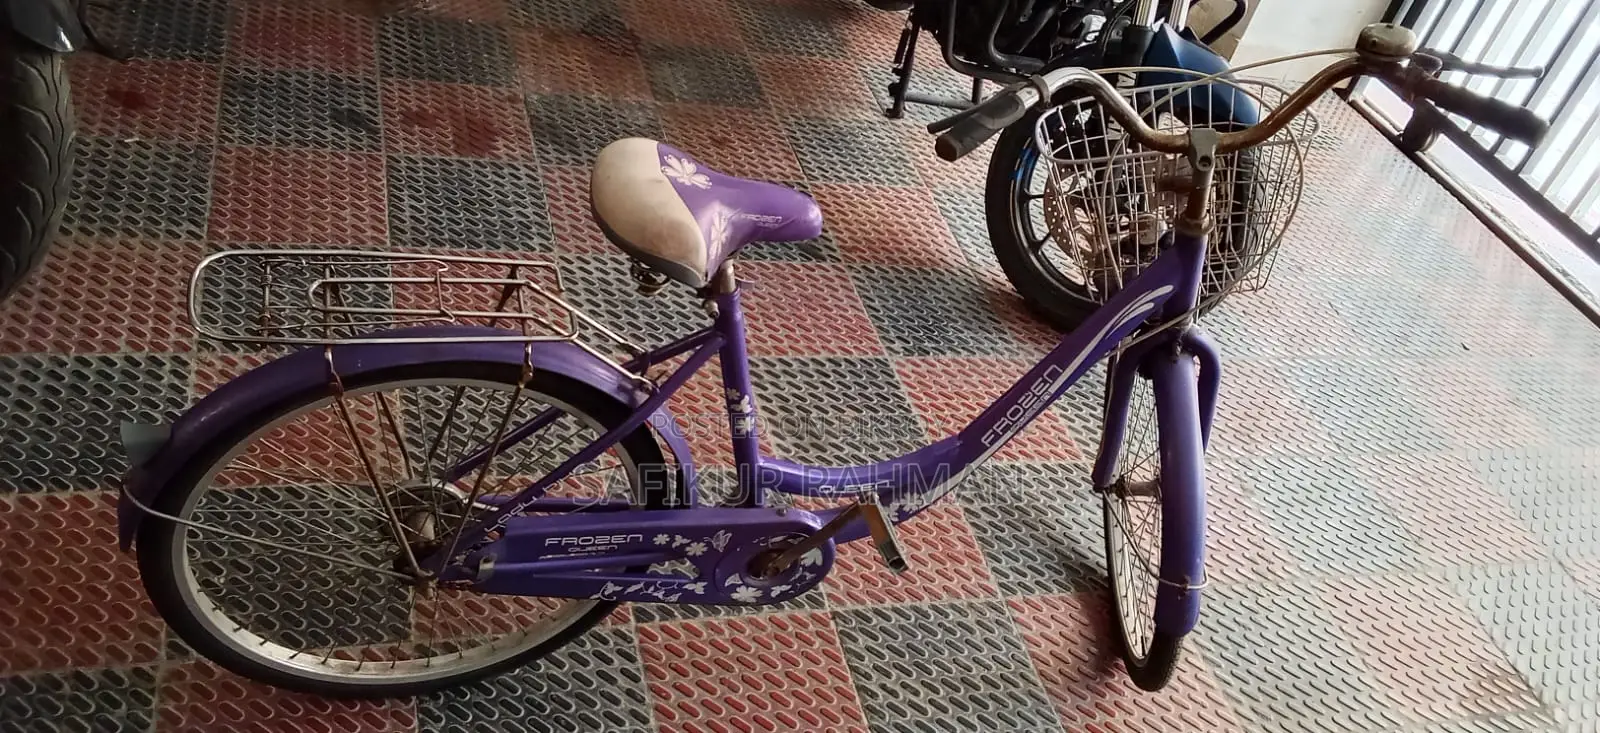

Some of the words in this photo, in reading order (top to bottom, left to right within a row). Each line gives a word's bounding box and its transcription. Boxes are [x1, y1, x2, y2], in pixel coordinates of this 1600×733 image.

[980, 363, 1063, 448] FROZEN
[818, 480, 890, 494] QUEEN
[544, 534, 643, 547] FROZEN
[567, 545, 618, 553] QUEEN
